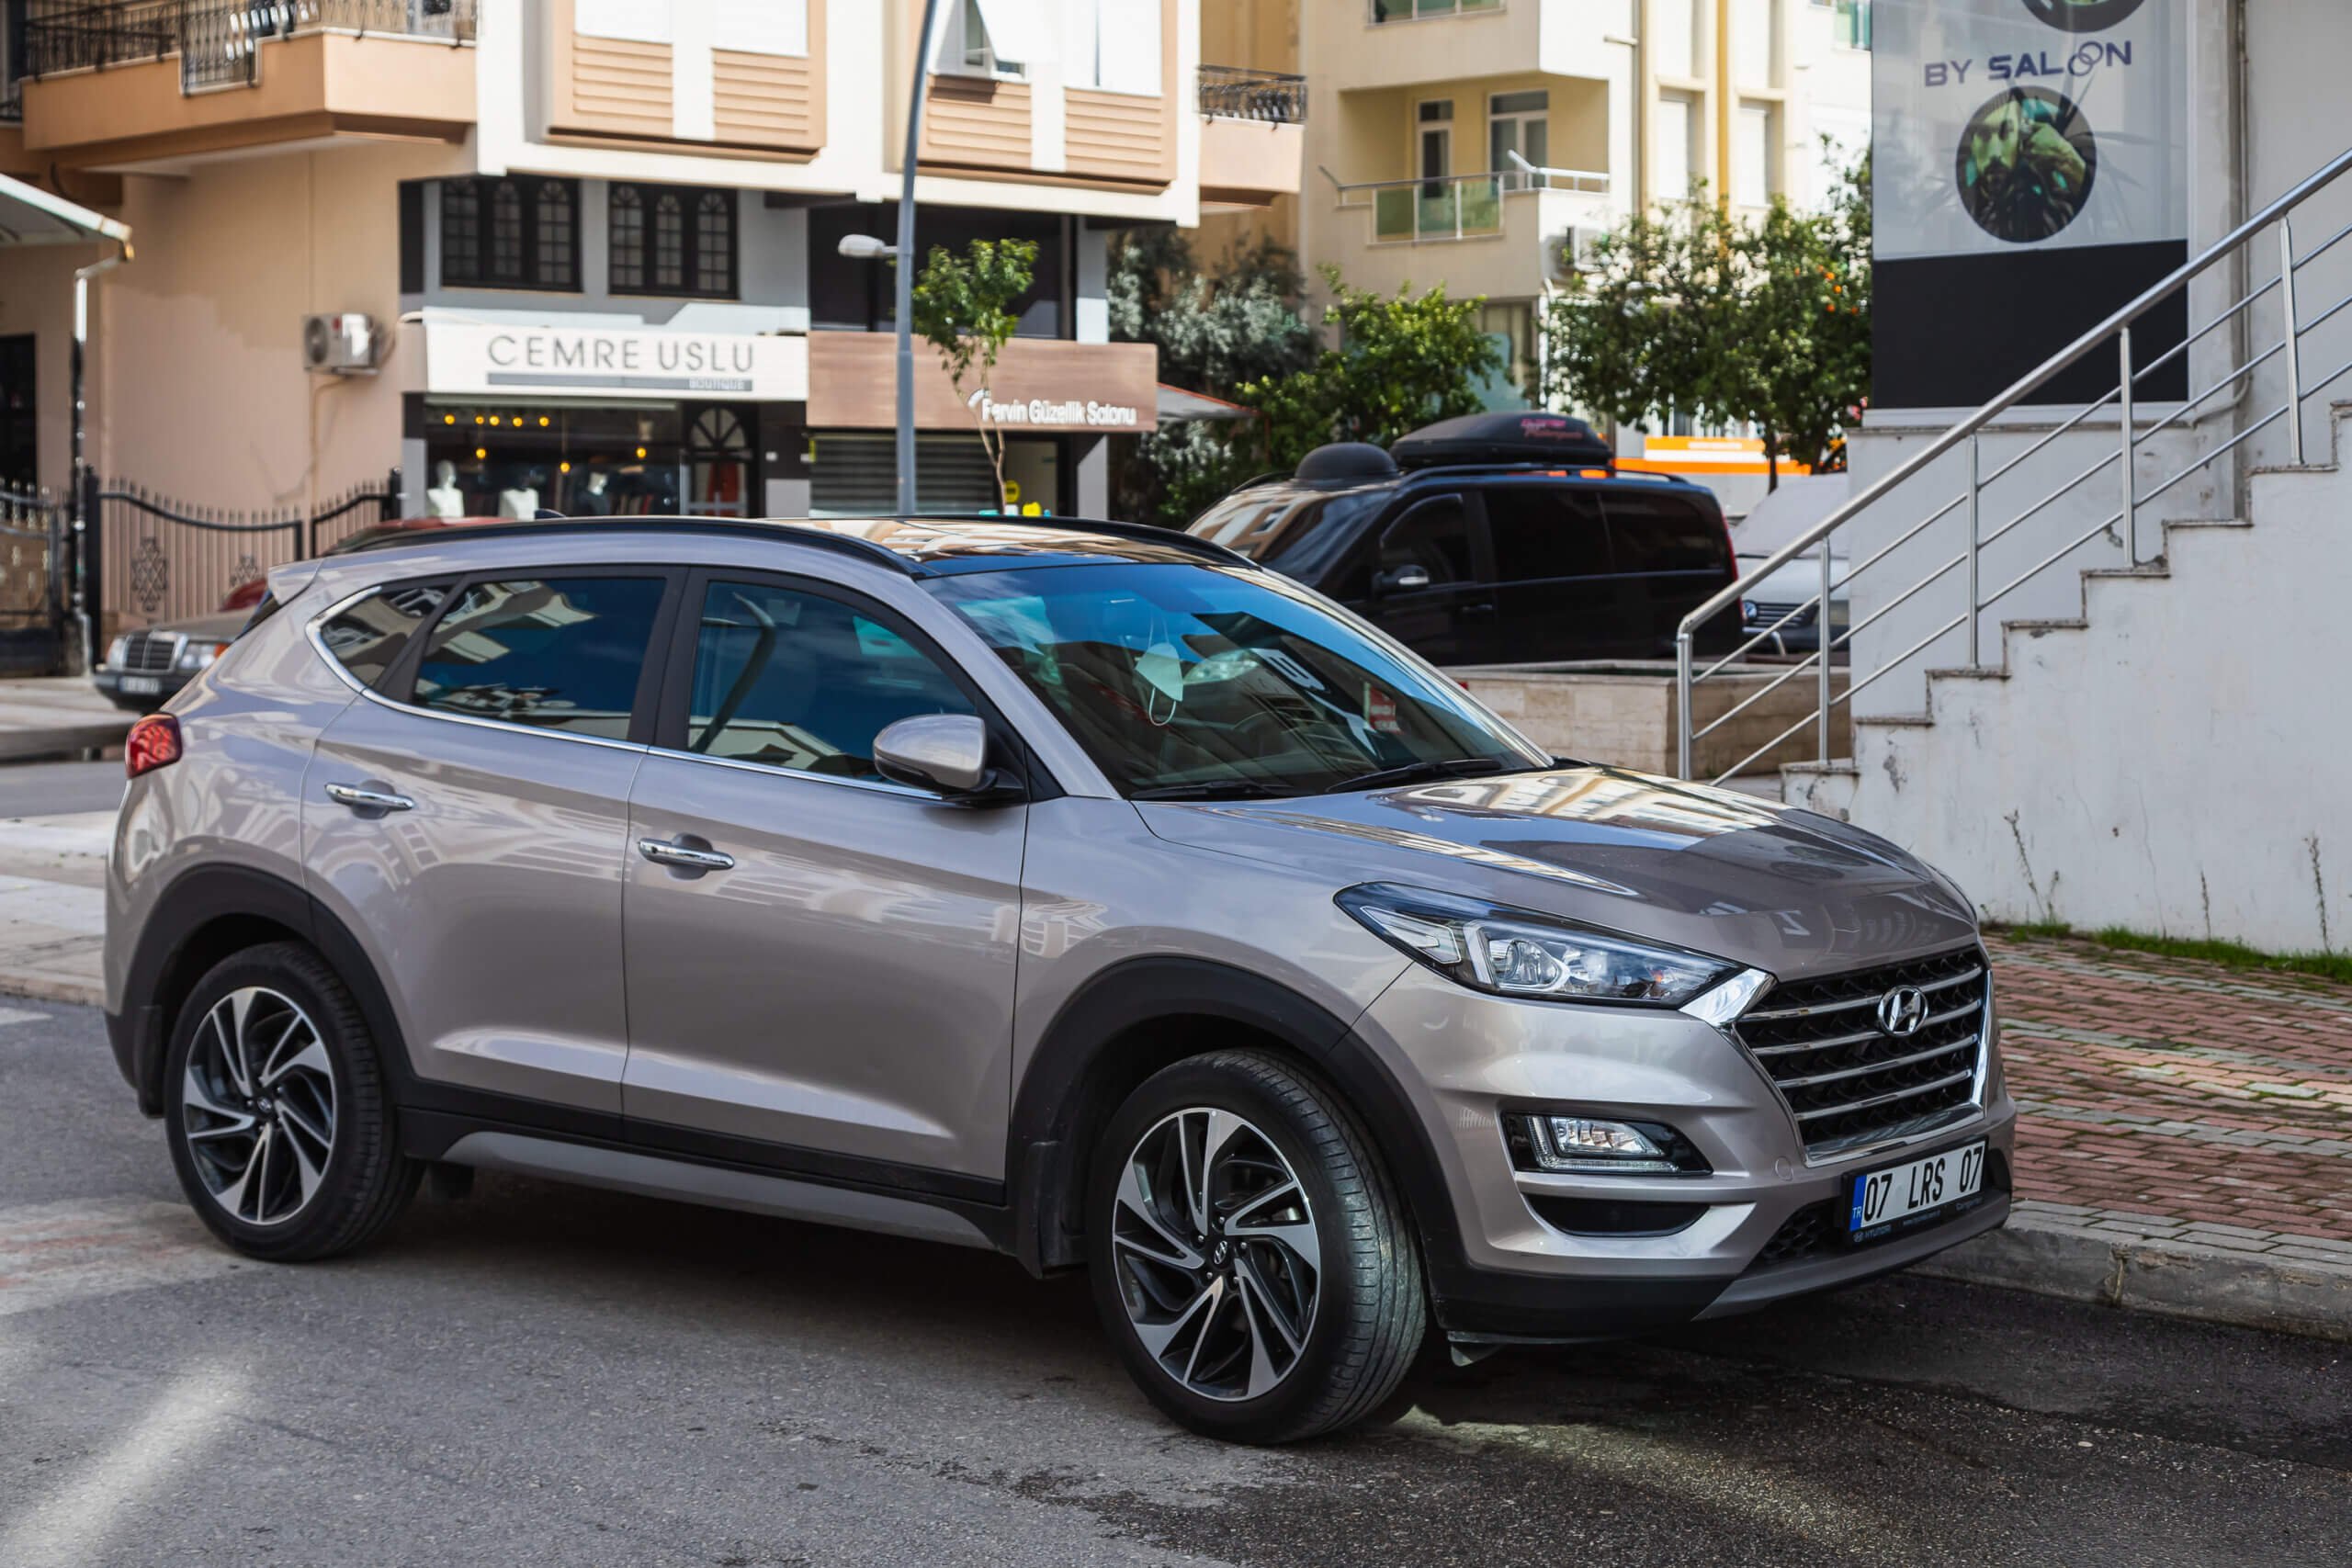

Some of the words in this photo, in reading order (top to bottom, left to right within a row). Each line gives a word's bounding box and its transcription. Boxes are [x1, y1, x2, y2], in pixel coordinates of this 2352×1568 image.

[1924, 59, 1973, 87] BY
[487, 334, 639, 369] CEMRE
[657, 340, 753, 373] USLU
[1086, 400, 1137, 426] Salonu
[1863, 1173, 1893, 1222] 07
[1907, 1157, 1945, 1209] LRS
[1959, 1145, 1984, 1193] 07
[1851, 1205, 1862, 1220] TR
